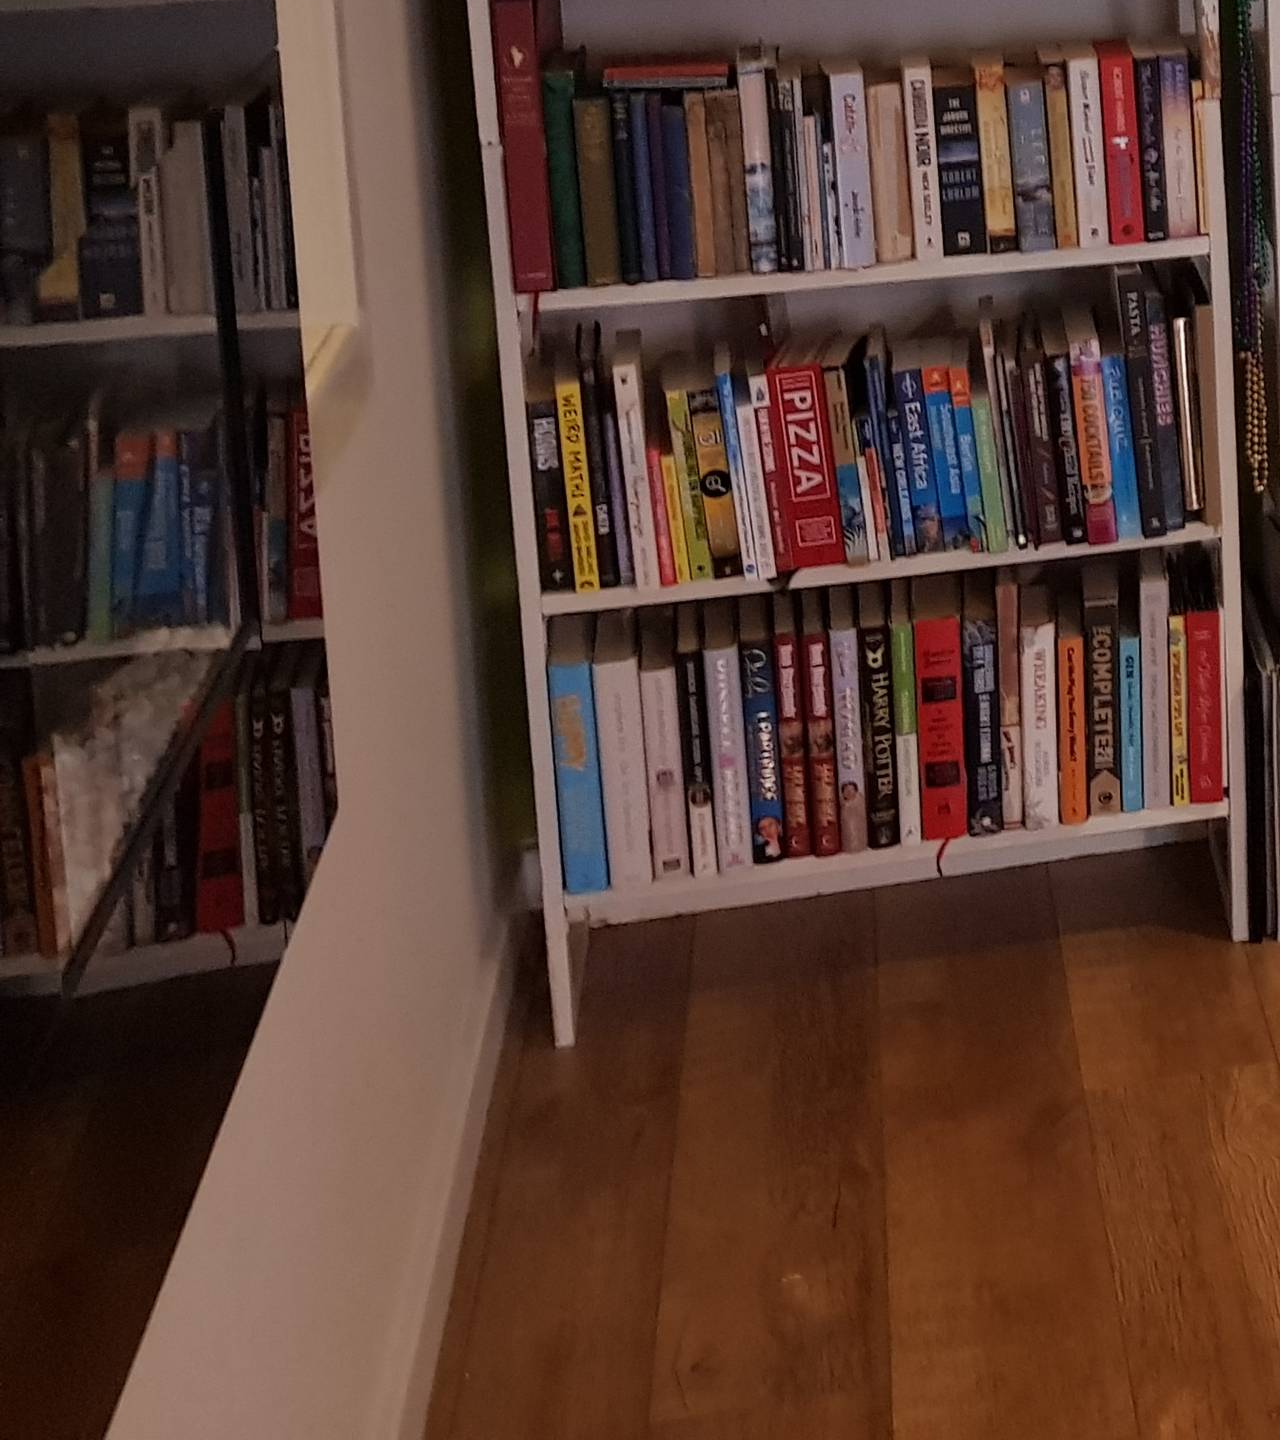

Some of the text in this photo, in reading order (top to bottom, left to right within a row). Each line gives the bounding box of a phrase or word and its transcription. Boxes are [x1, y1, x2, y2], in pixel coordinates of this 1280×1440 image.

[1127, 291, 1142, 337] PASTA
[563, 392, 581, 445] WEIRD
[783, 389, 824, 495] PIZZA
[903, 401, 929, 491] East Africa
[1082, 403, 1105, 482] COCKTAILS
[1033, 647, 1047, 731] WREAKING
[1092, 635, 1114, 749] COMPLETE
[759, 720, 778, 802] PARTRIDGE
[871, 671, 893, 799] HARRY POTTER
